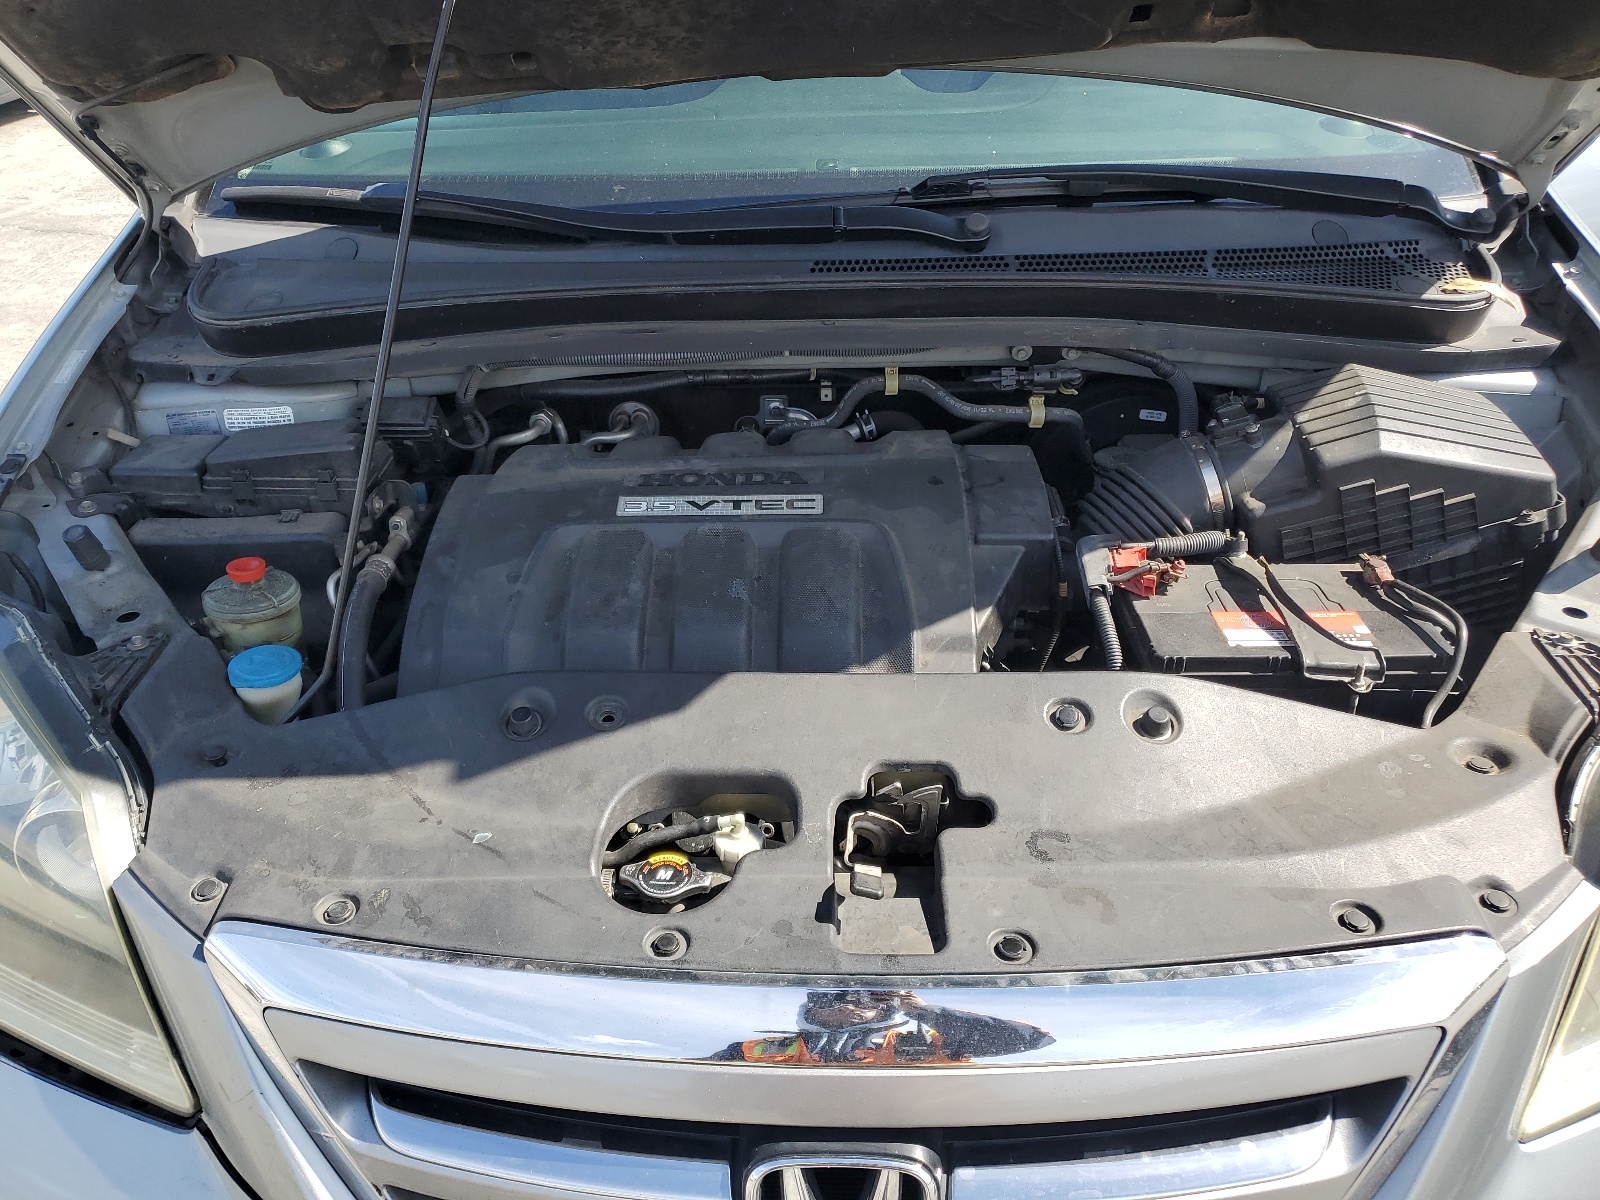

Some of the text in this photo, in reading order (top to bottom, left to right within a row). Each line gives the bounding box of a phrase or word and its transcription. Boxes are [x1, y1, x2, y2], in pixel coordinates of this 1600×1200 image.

[638, 471, 809, 487] HONDA
[623, 498, 816, 512] 3.5 VTEC
